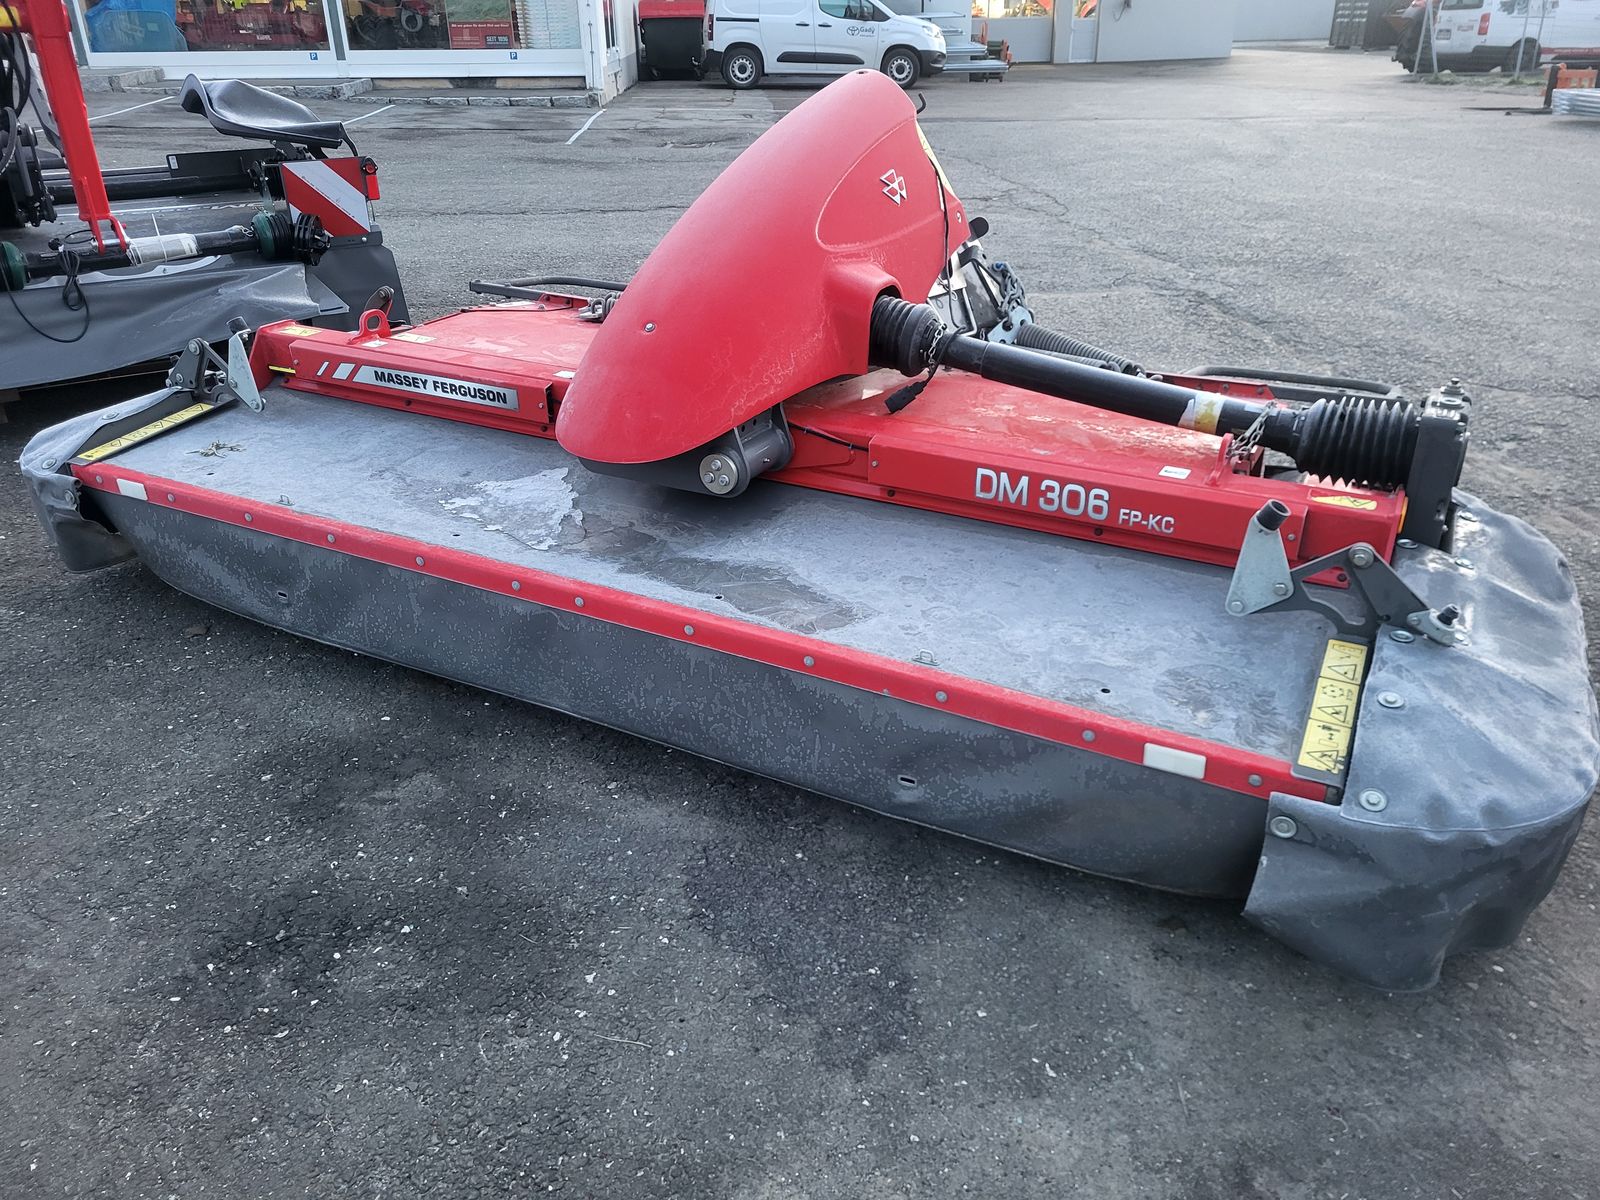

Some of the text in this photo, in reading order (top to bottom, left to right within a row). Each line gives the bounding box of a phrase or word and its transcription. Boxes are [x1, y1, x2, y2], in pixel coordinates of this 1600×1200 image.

[374, 370, 507, 404] MASSEY FERGUSON
[975, 467, 1176, 534] DM 306 FP-KC
